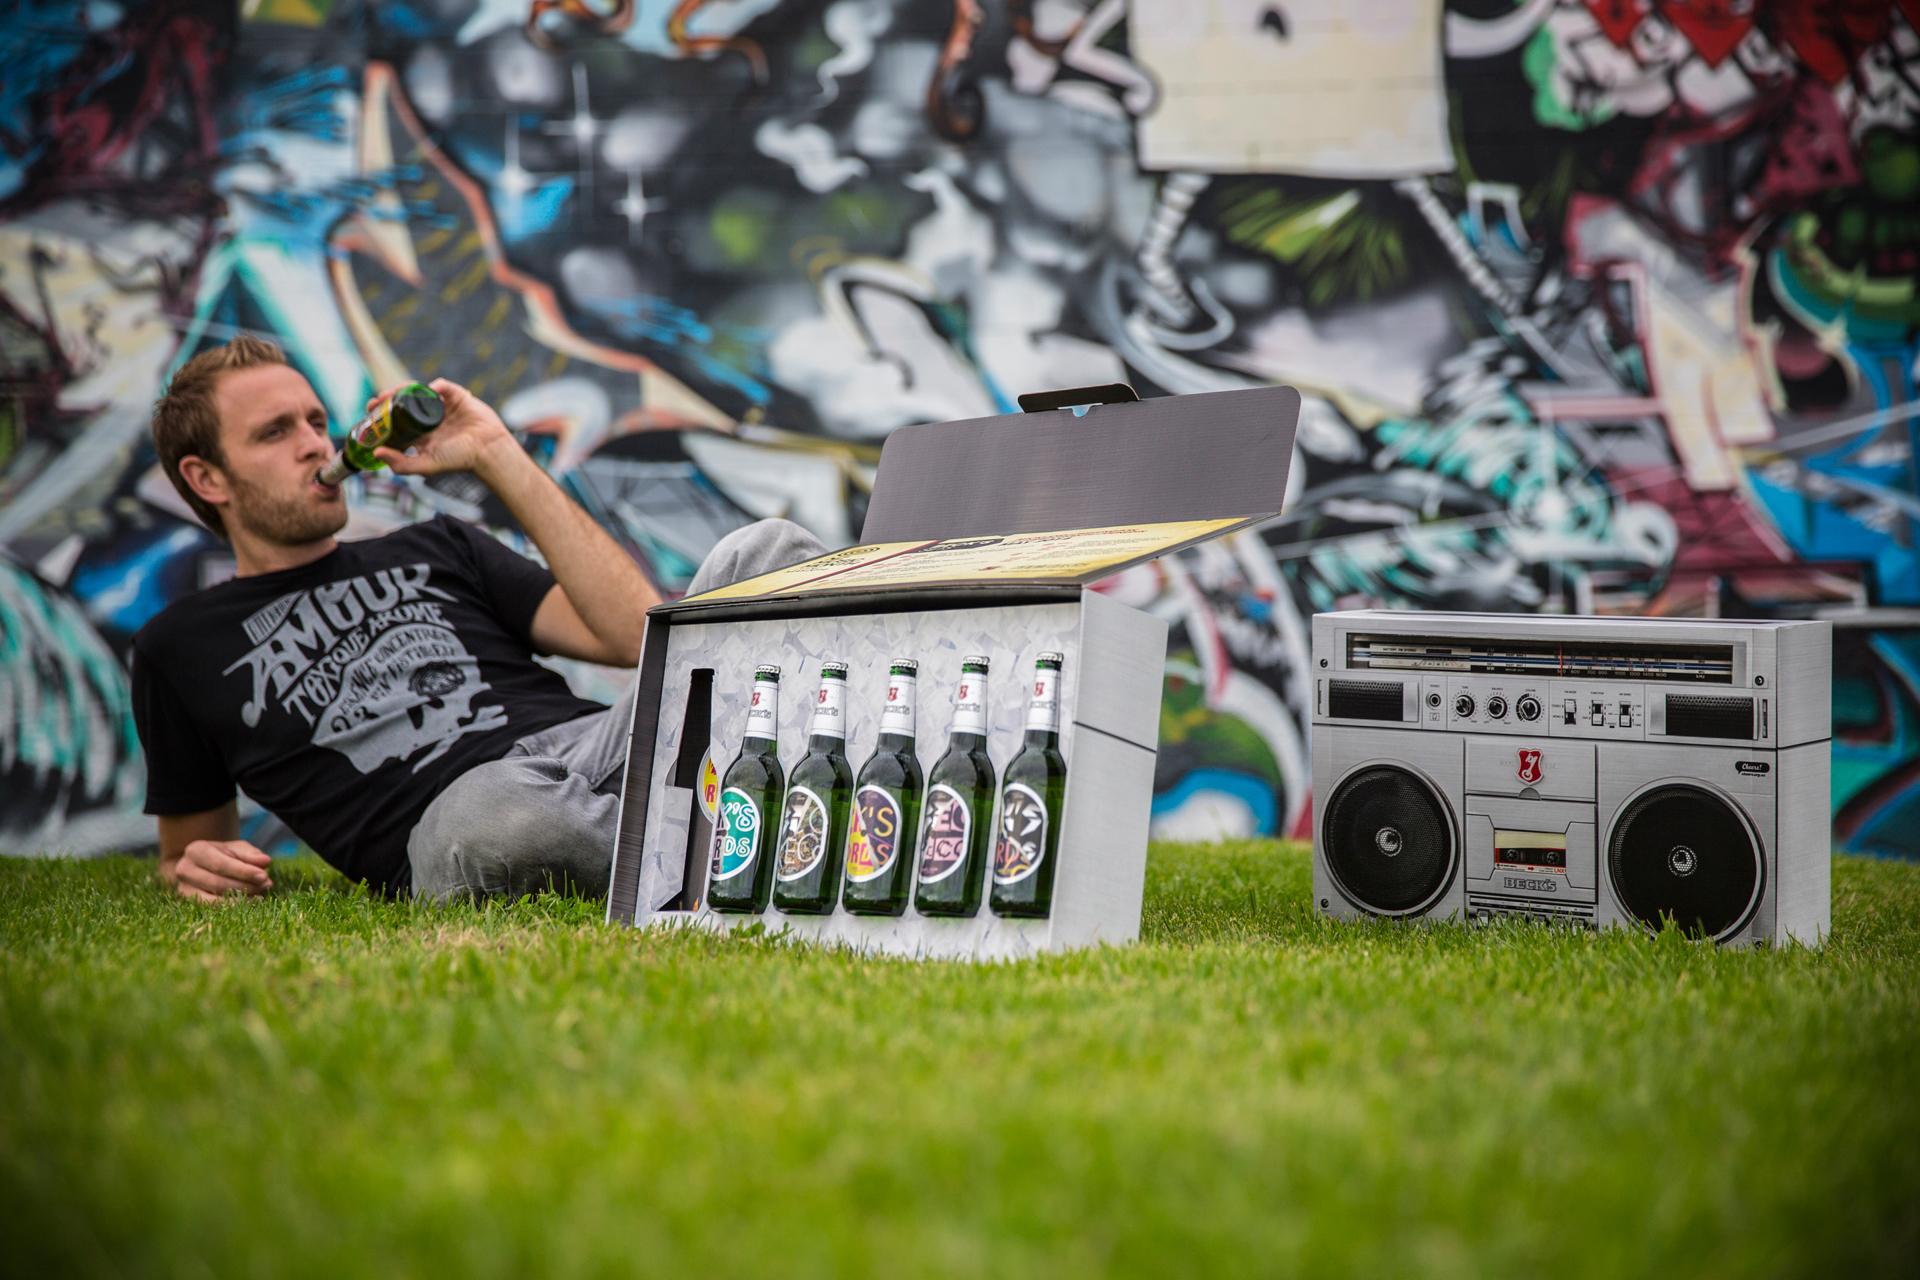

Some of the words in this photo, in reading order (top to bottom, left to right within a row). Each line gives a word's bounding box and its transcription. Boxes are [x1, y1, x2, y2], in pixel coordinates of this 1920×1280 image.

[222, 563, 459, 728] AMOUR
[281, 627, 370, 728] TOXIQUE
[367, 602, 457, 637] AROME
[1741, 763, 1763, 771] Cheers!
[1503, 876, 1557, 893] BECK'S
